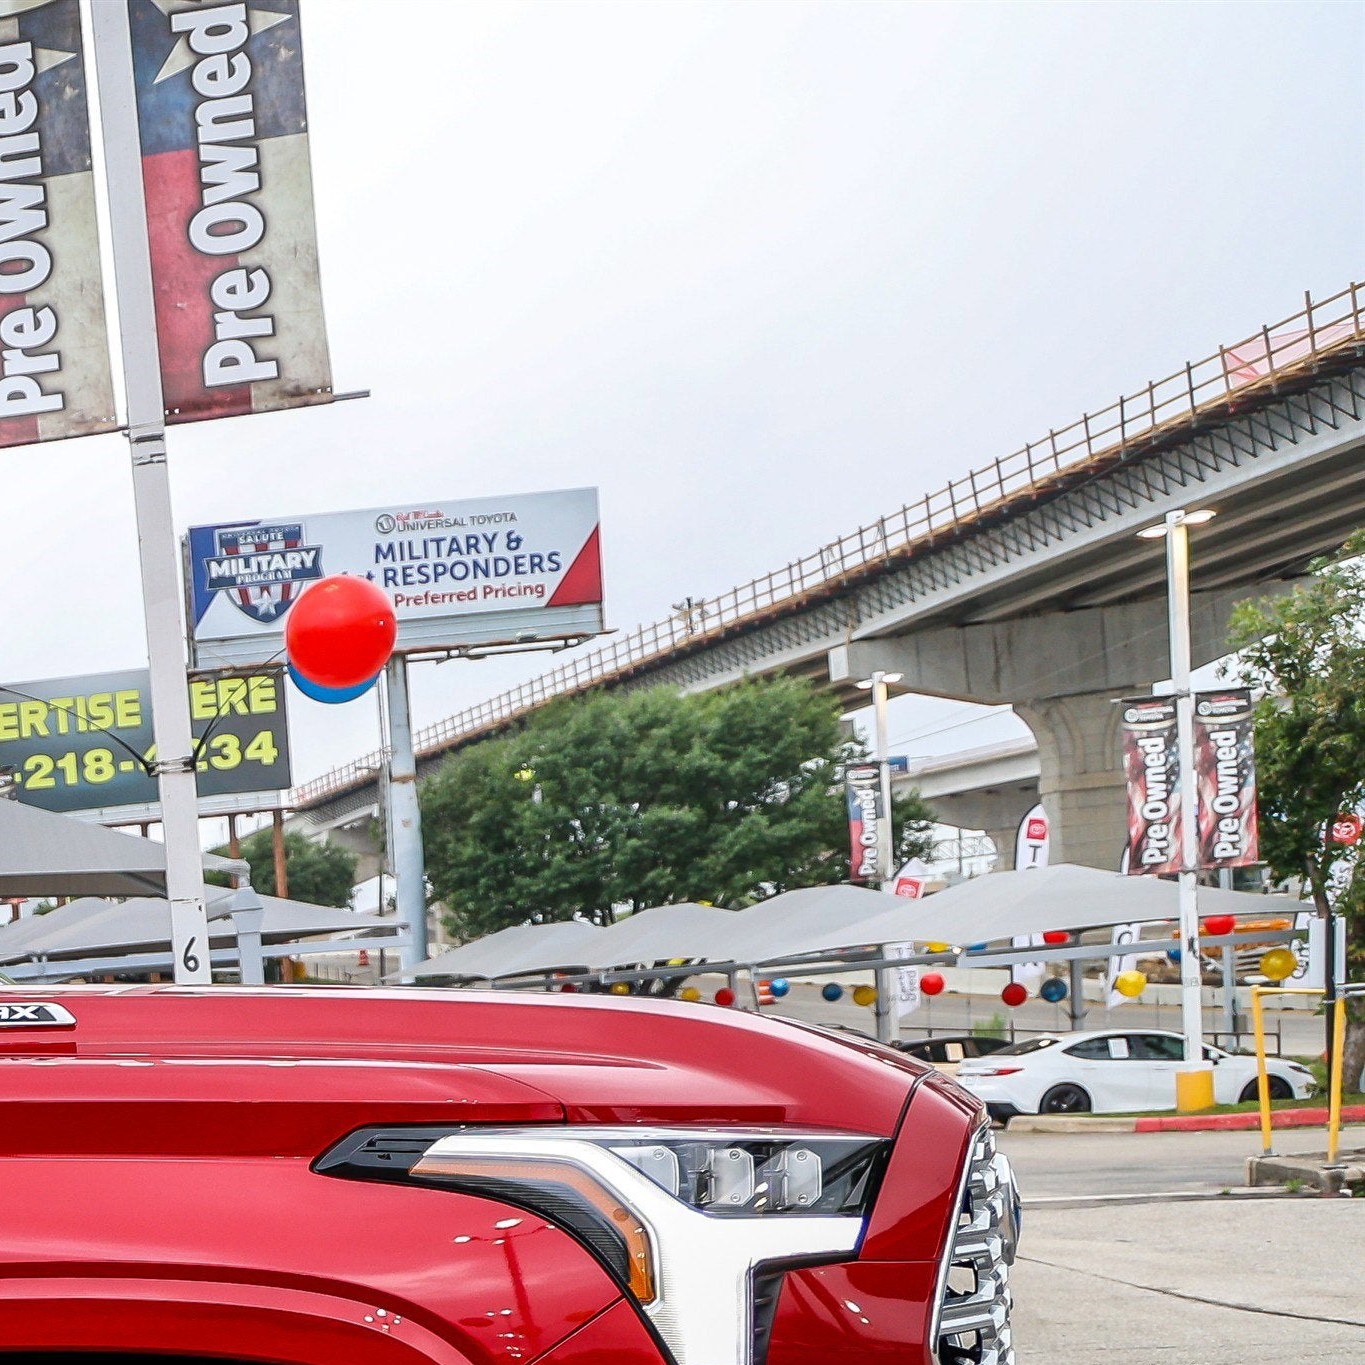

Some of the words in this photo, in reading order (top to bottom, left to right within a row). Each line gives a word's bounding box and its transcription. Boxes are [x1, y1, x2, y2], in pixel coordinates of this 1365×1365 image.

[171, 4, 266, 255] Owned
[203, 266, 279, 388] Pre
[239, 532, 284, 544] SALUTE
[397, 517, 467, 532] UNIVERSAL
[469, 512, 517, 526] TOYOTA
[209, 550, 317, 577] MILITARY
[375, 531, 500, 564] MILITARY
[507, 530, 524, 551] &
[384, 551, 563, 588] RESPONDERS
[395, 586, 478, 607] Preferred
[483, 582, 546, 601] Pricing
[190, 676, 277, 720] ERE
[1137, 736, 1168, 820] Owned
[1210, 730, 1240, 814] Owned
[856, 789, 877, 846] Owned
[1214, 817, 1241, 858] Pre
[1142, 824, 1168, 865] Pre
[183, 936, 200, 973] 6
